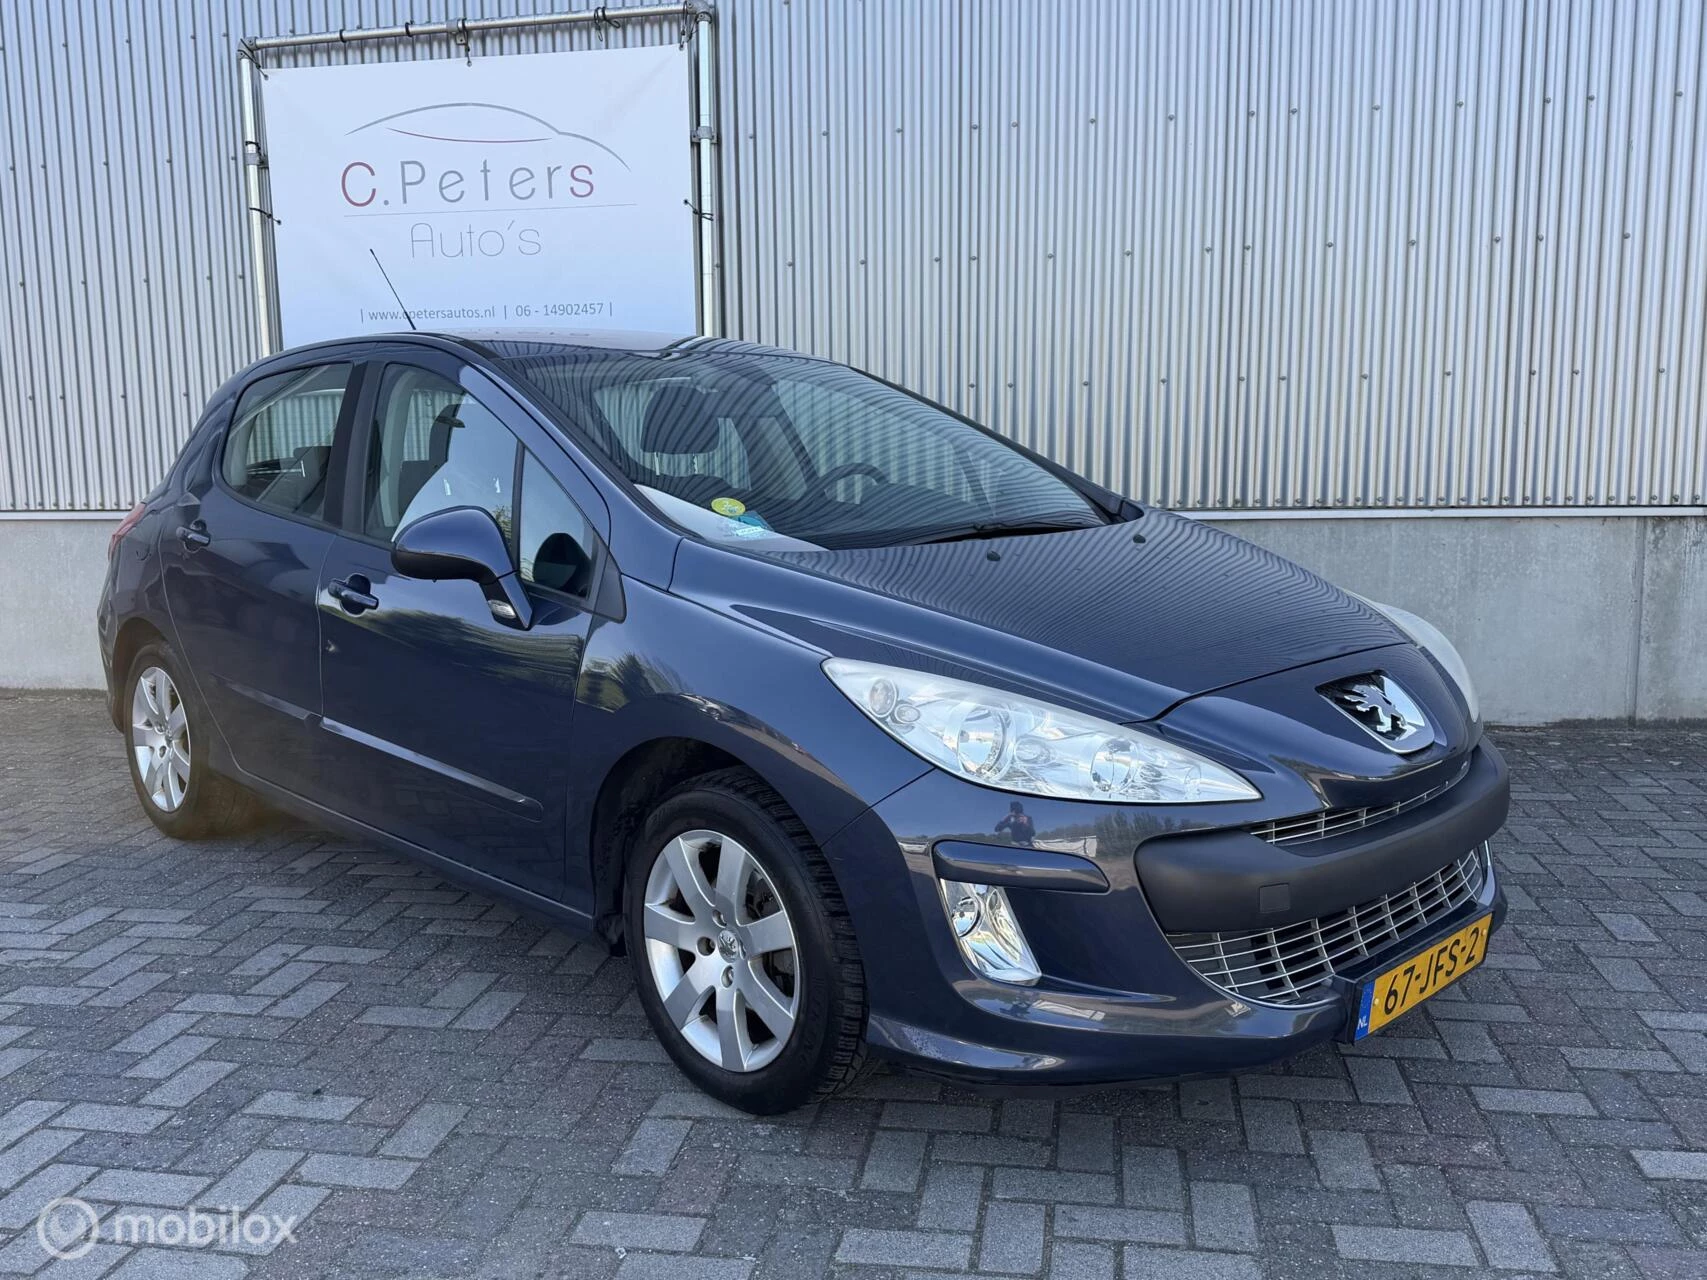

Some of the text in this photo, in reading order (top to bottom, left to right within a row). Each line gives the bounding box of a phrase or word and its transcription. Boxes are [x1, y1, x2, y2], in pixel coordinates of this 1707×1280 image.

[515, 304, 532, 317] 06
[543, 302, 605, 316] 14902457
[1383, 926, 1480, 1016] 67-JFS-2
